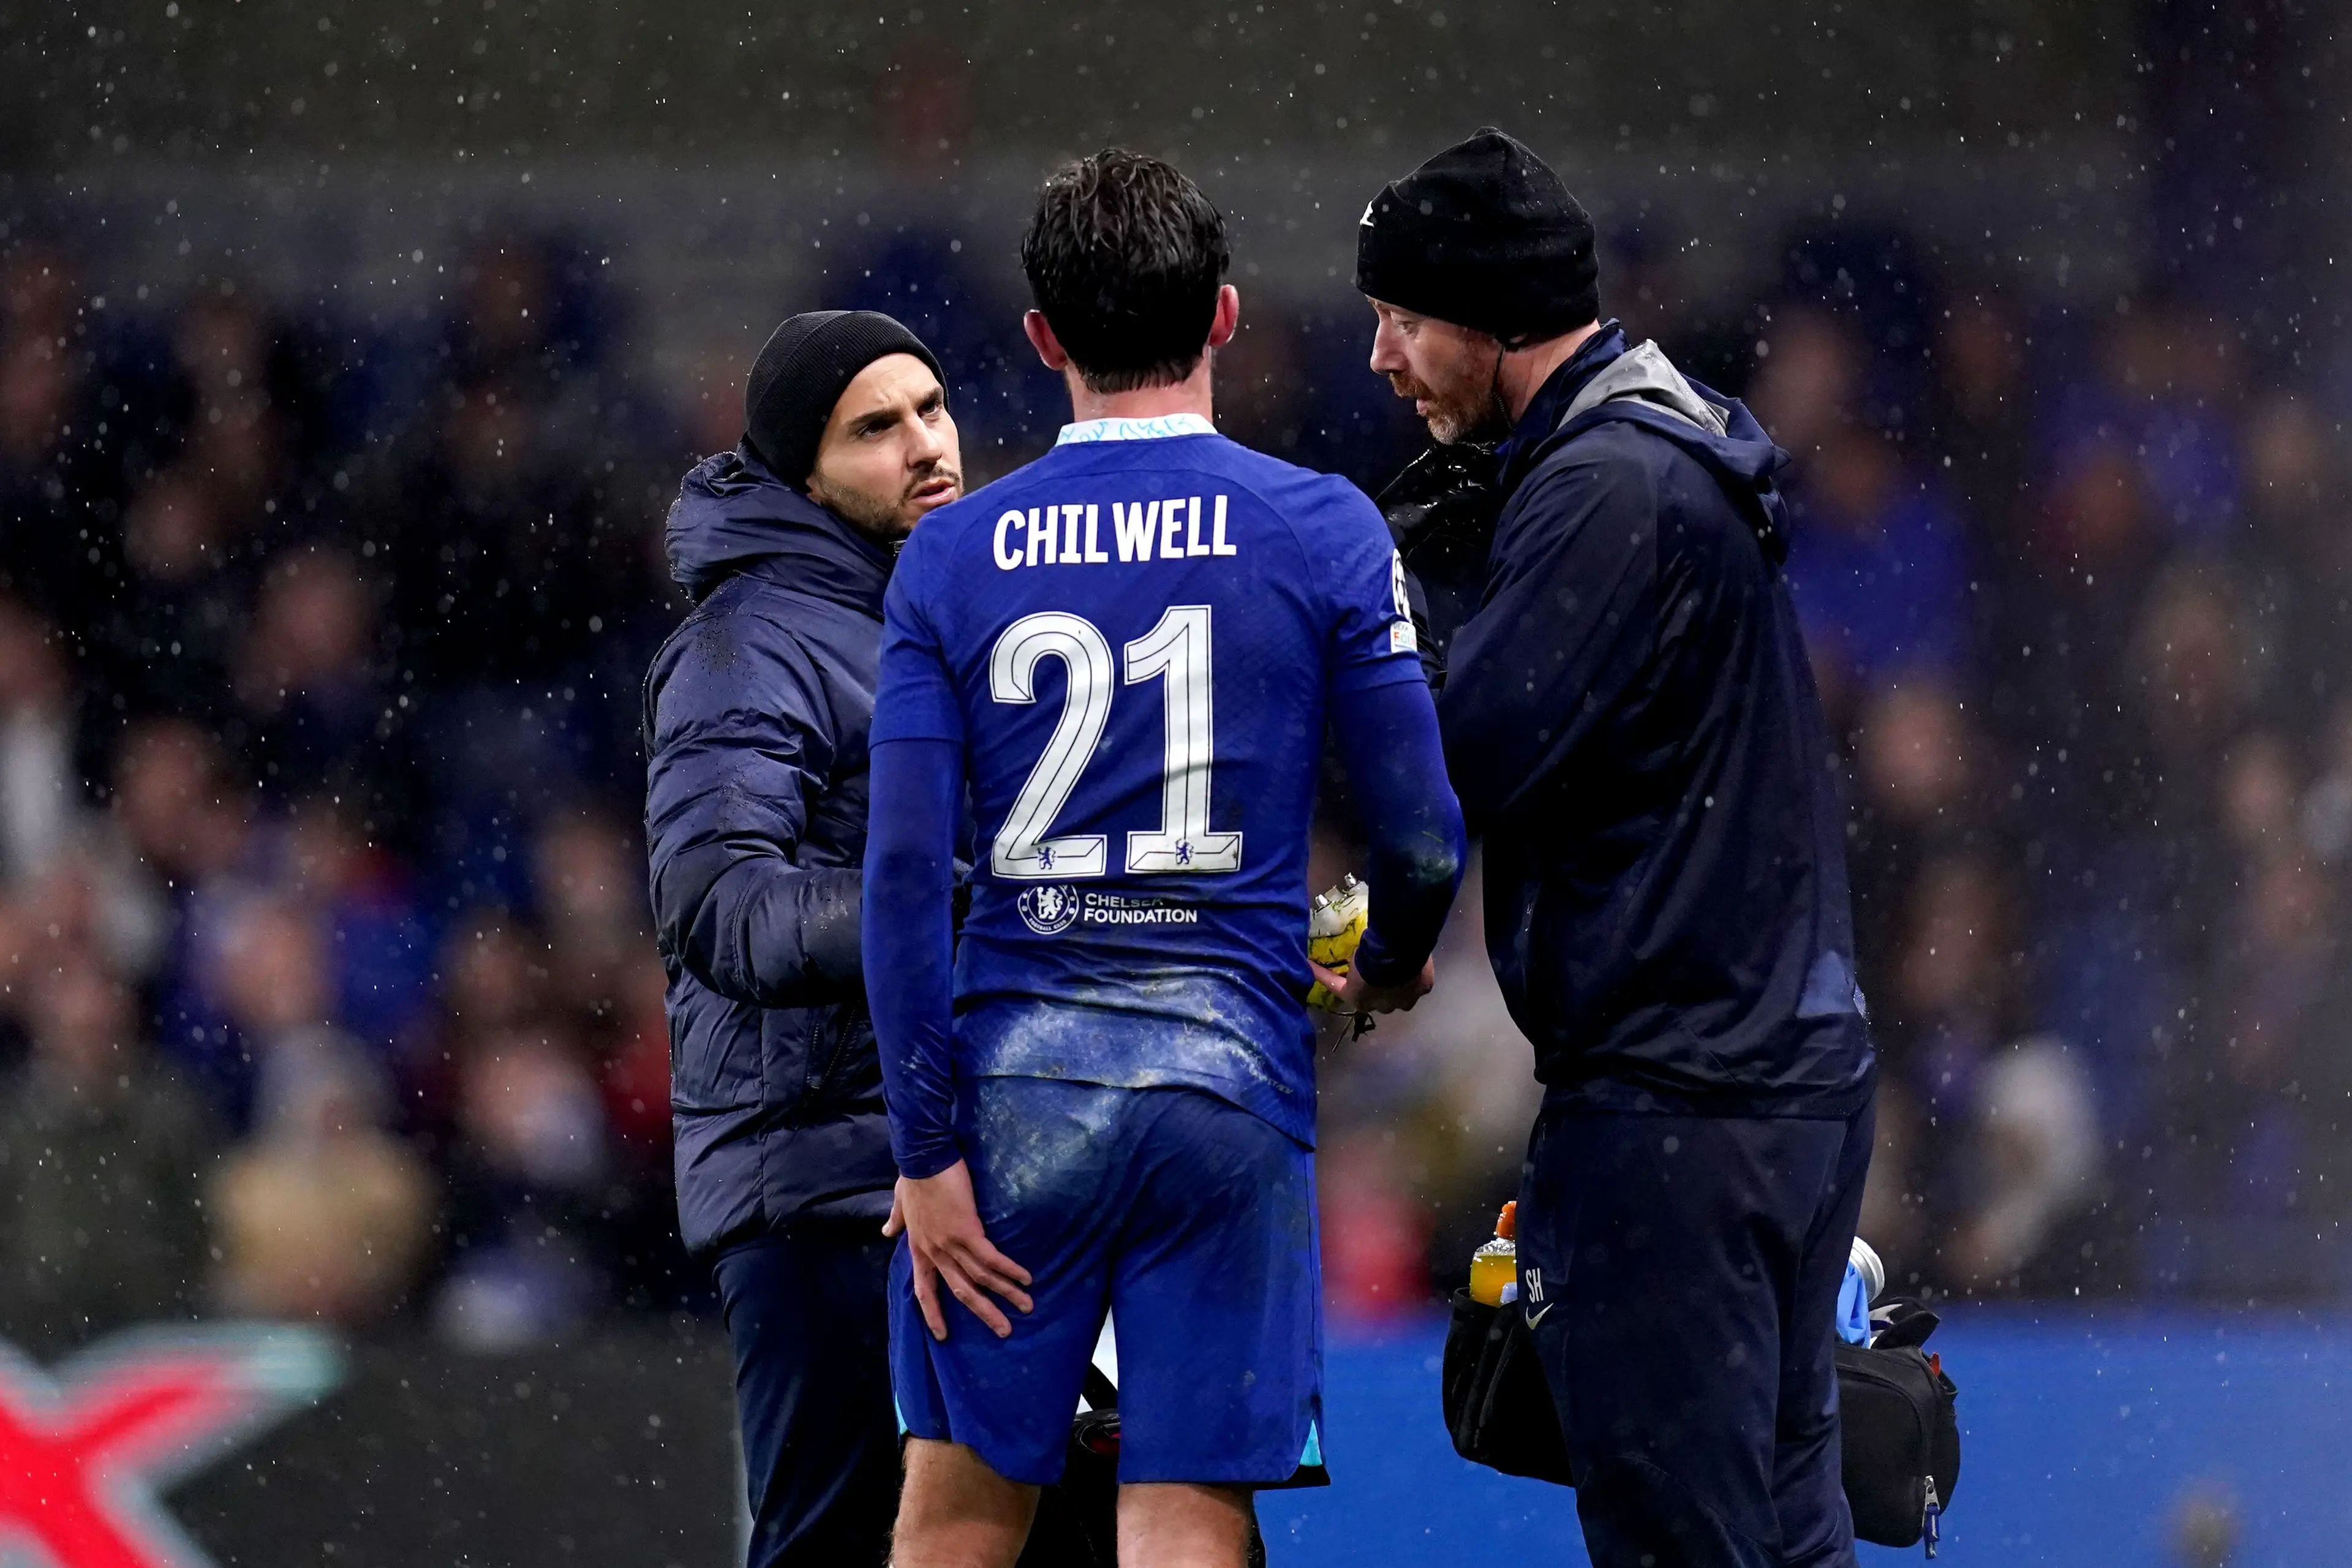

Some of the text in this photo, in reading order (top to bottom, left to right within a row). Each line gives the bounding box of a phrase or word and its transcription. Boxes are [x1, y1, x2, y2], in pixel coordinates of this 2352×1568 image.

[993, 495, 1237, 570] CHILWELL
[989, 605, 1243, 880] 21
[1084, 908, 1197, 924] FOUNDATION
[1525, 1267, 1544, 1303] SH
